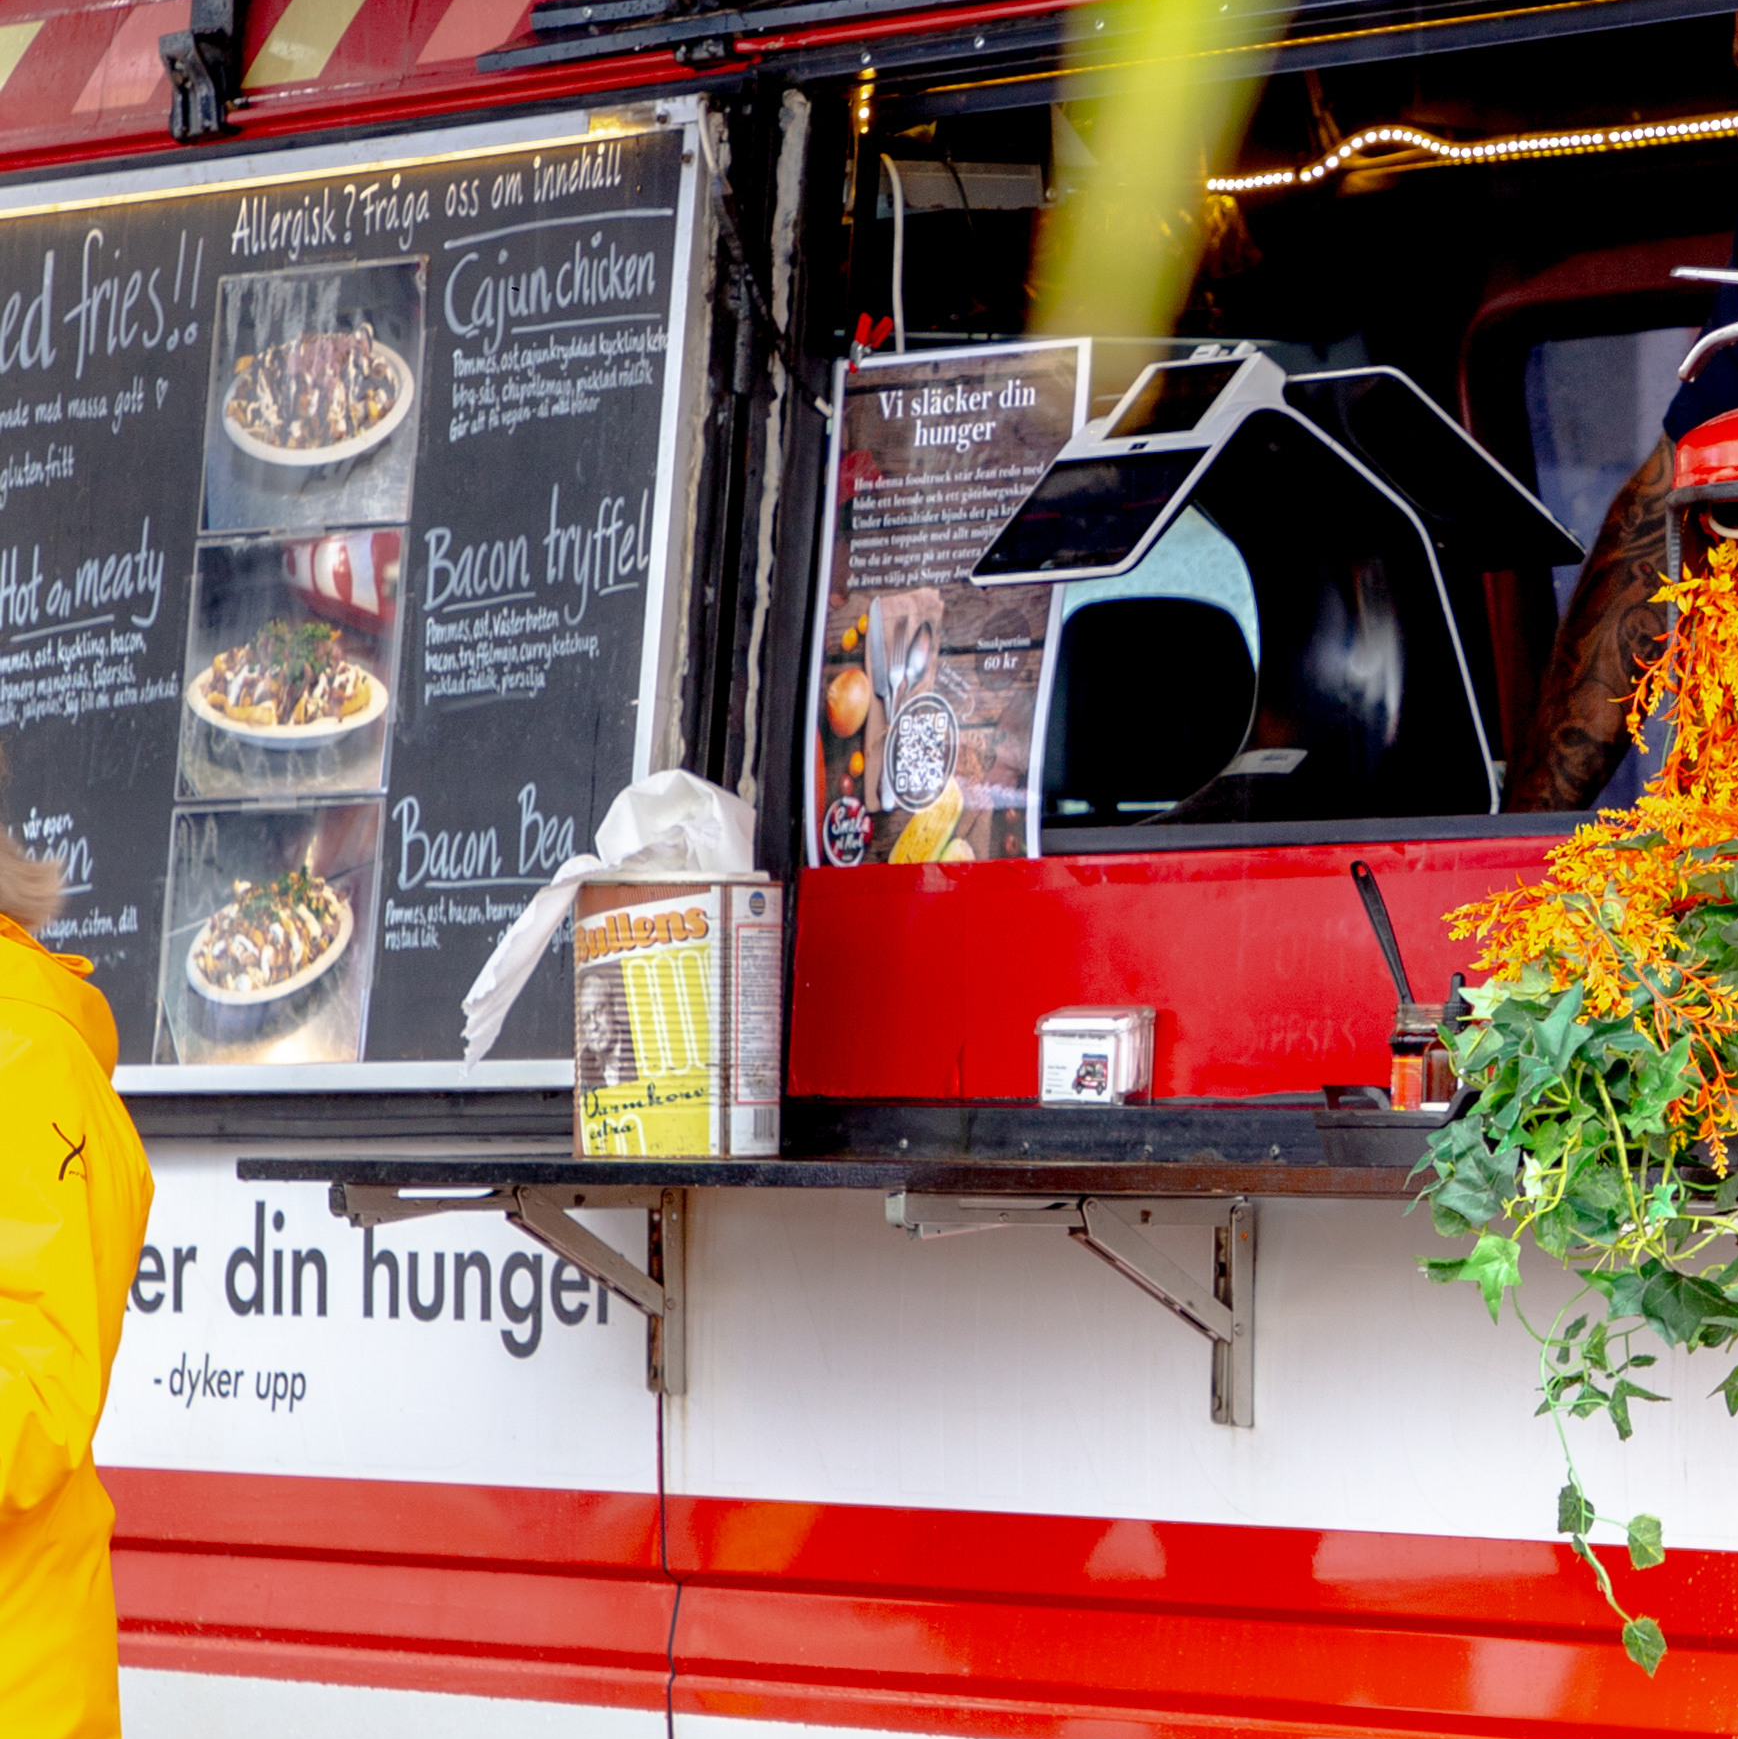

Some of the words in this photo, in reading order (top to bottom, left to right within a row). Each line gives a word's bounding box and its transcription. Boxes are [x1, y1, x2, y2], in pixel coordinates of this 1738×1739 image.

[360, 173, 430, 251] Fråga
[445, 178, 481, 217] oss
[491, 171, 524, 210] om
[532, 143, 623, 204] innehåll
[0, 248, 57, 375] ed
[444, 247, 552, 356] Cajun
[556, 230, 656, 309] chicken
[35, 392, 62, 424] med
[68, 394, 108, 421] massa
[112, 375, 145, 435] gott
[879, 389, 904, 421] Vi
[910, 384, 993, 417] släcker
[999, 378, 1036, 410] din
[913, 418, 997, 454] hunger
[74, 514, 165, 628] meaty
[423, 526, 531, 612] Bacon
[543, 482, 649, 626] tryffel
[983, 655, 1000, 671] 60
[1002, 651, 1019, 670] kr
[392, 795, 503, 892] Bacon
[574, 907, 708, 963] Bullens
[126, 1244, 198, 1315] er
[224, 1201, 328, 1318] din
[169, 1352, 244, 1409] dyker
[255, 1368, 307, 1413] upp
